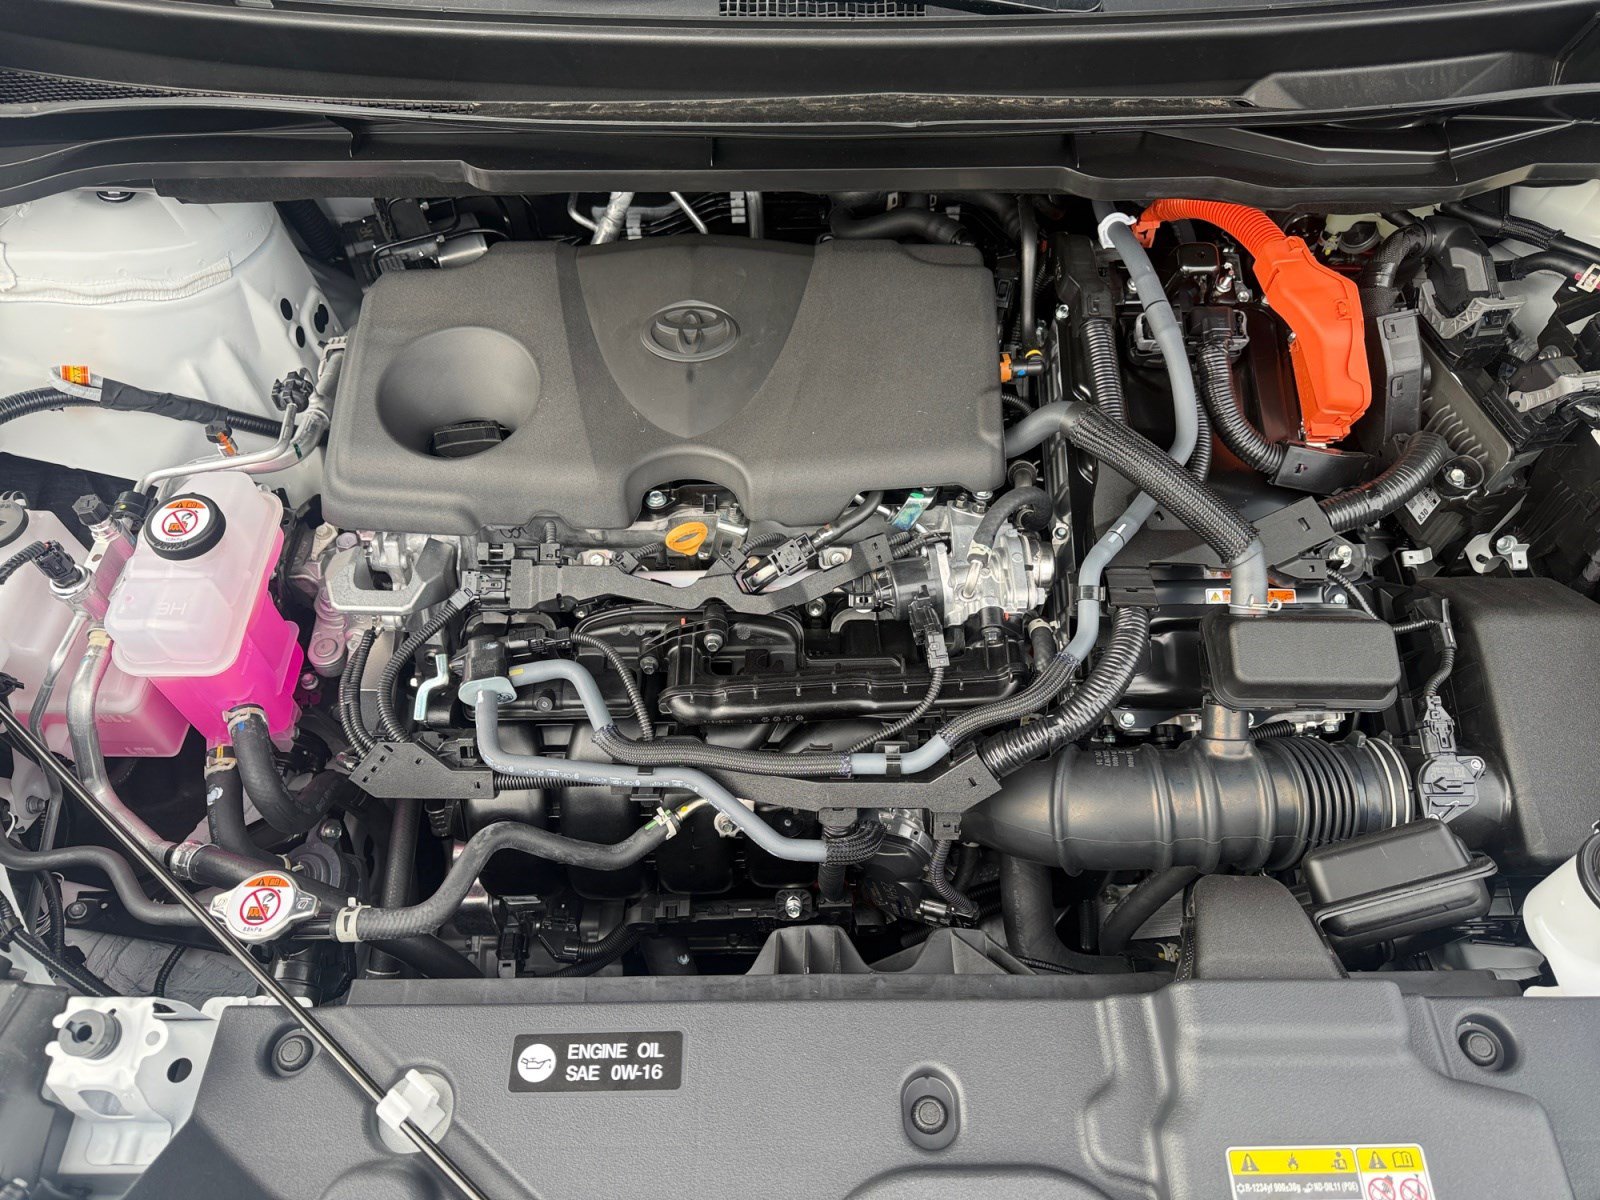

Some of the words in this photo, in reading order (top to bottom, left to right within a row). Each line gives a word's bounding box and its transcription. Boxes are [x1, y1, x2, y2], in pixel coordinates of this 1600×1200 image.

[567, 1043, 628, 1059] ENGINE
[637, 1042, 665, 1058] OIL
[565, 1065, 600, 1081] SAE
[611, 1064, 663, 1080] 0W-16
